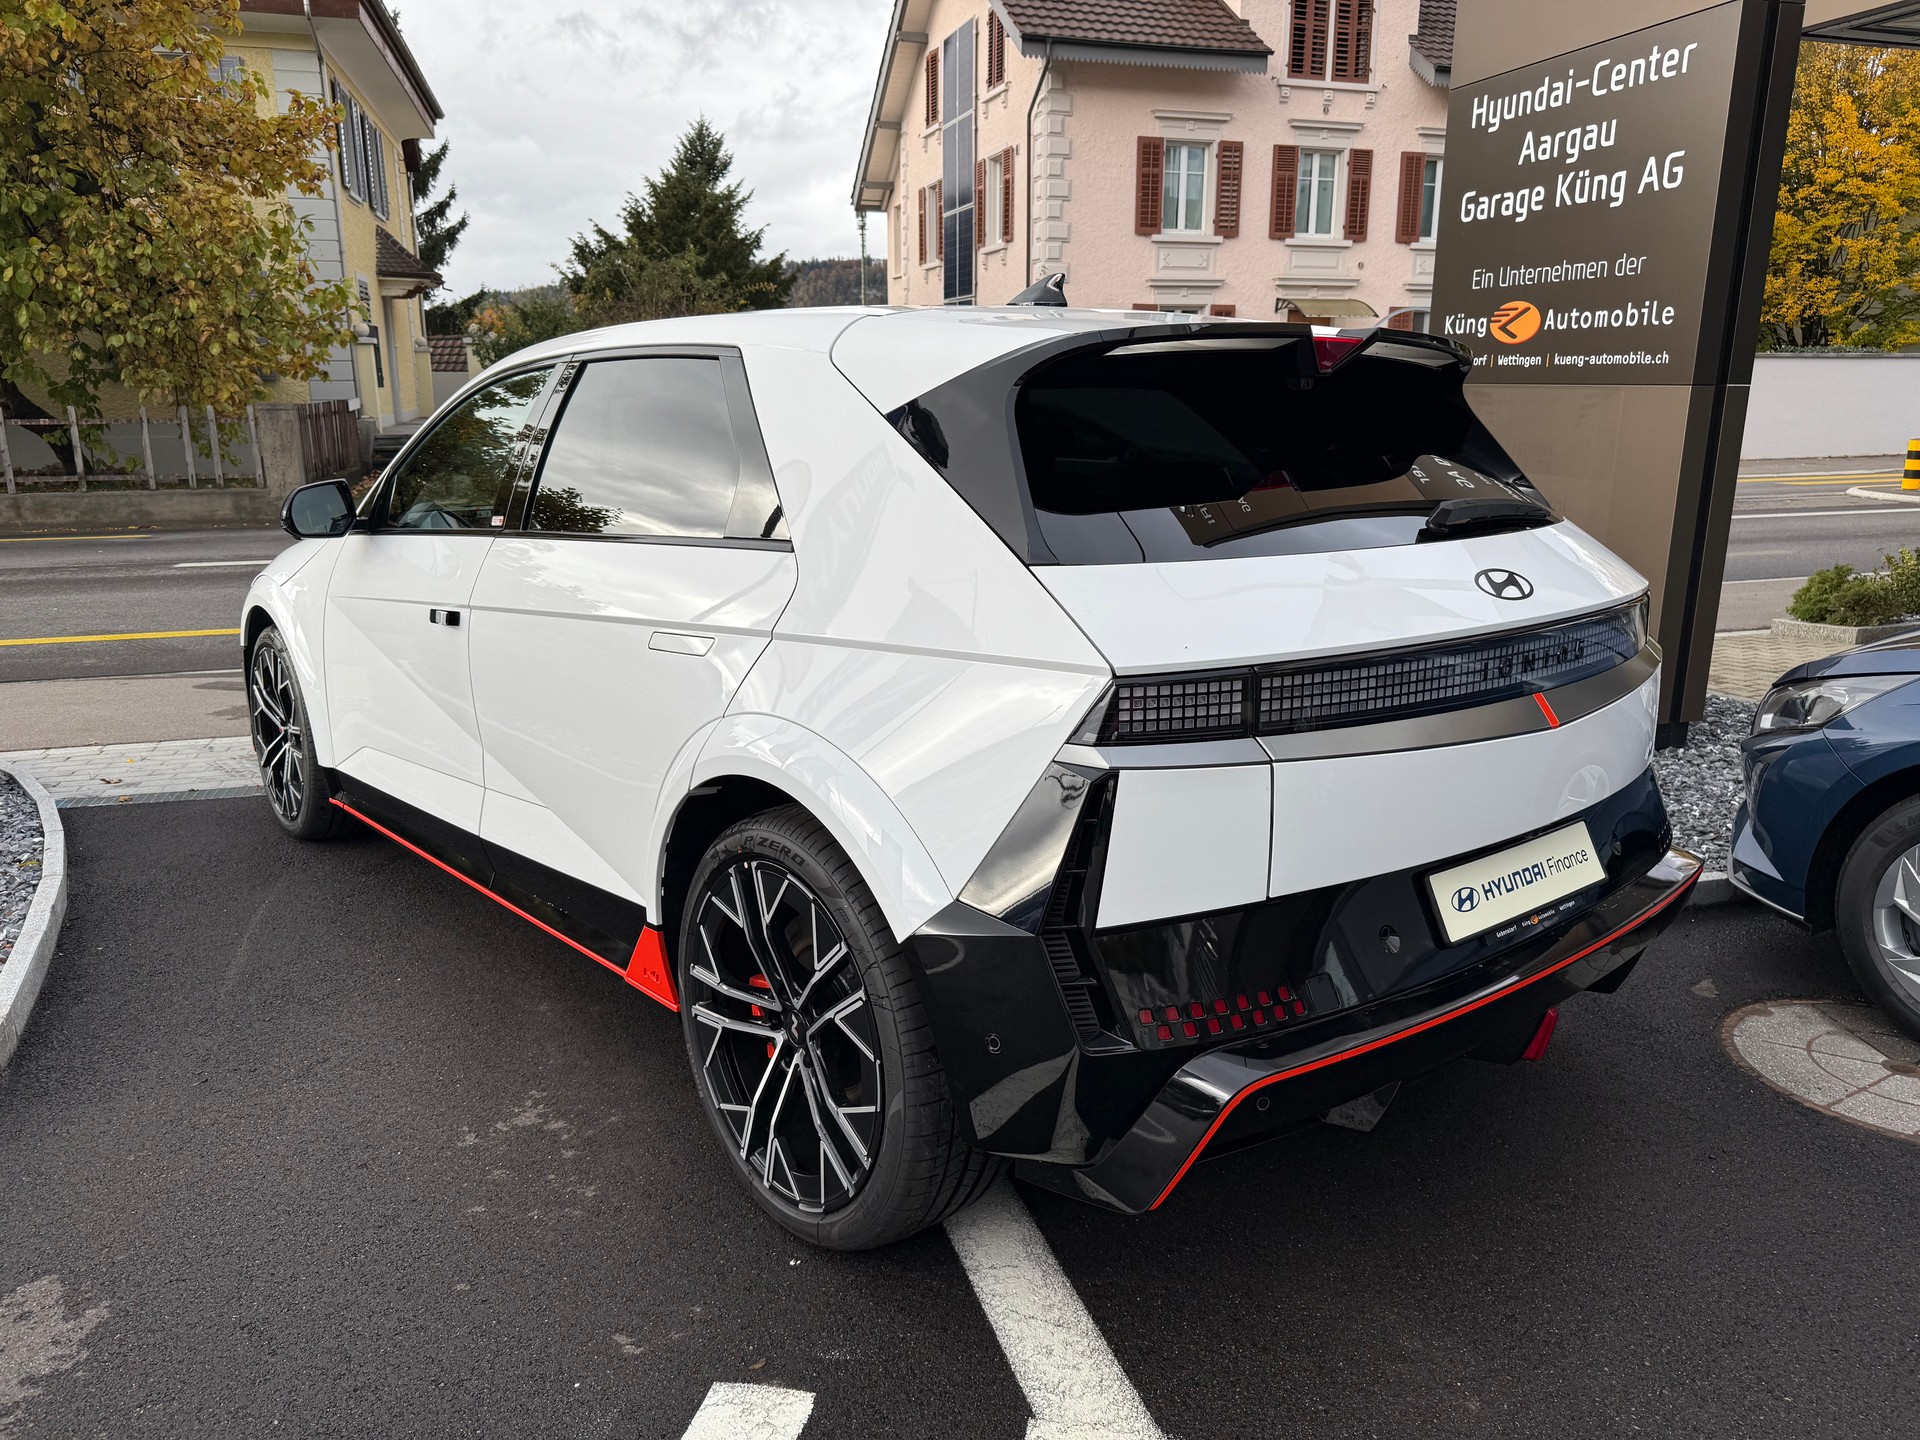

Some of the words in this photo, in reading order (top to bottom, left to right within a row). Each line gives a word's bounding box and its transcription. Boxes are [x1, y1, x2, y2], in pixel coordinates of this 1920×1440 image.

[1471, 43, 1698, 133] Hyundai-Center
[1517, 119, 1617, 165] Aargau
[1460, 185, 1545, 223] Garage
[1555, 169, 1627, 208] Küng
[1637, 150, 1686, 195] AG
[1472, 269, 1494, 290] Ein
[1499, 260, 1608, 288] Unternehmen
[1614, 253, 1647, 277] der
[1444, 313, 1488, 338] Küng
[1544, 301, 1675, 331] Automobile
[1497, 353, 1542, 368] Wettingen
[1554, 351, 1669, 367] kueng-automobile.ch
[756, 836, 807, 868] ZERO
[1481, 861, 1547, 901] HYUNDAI
[1546, 849, 1589, 876] Finance
